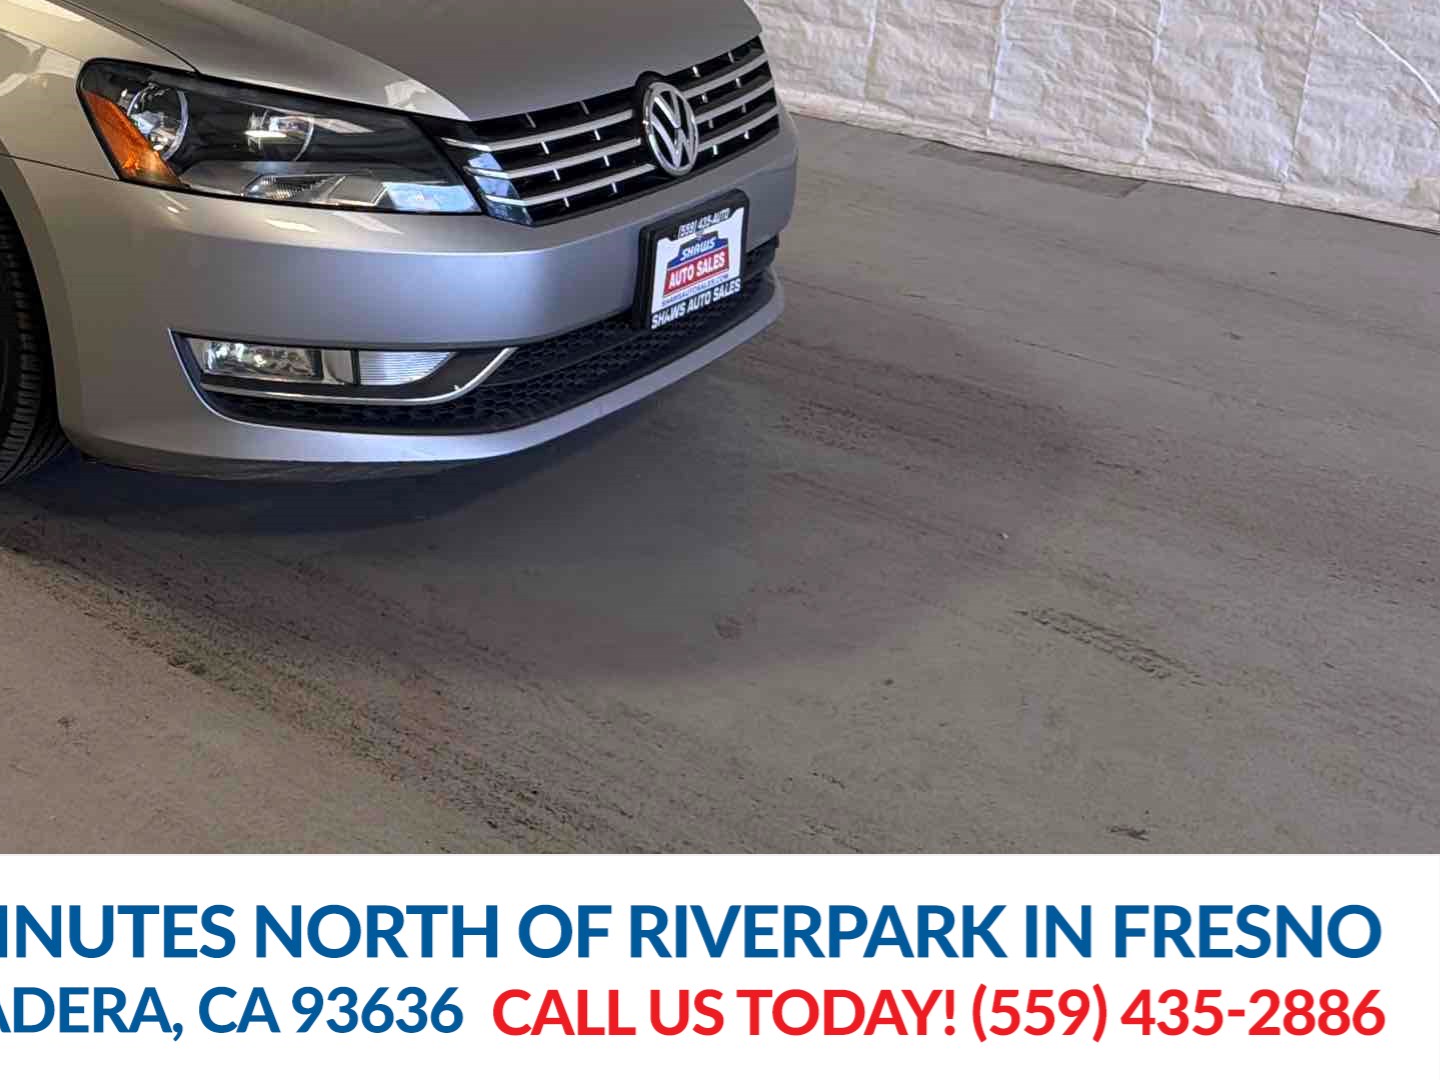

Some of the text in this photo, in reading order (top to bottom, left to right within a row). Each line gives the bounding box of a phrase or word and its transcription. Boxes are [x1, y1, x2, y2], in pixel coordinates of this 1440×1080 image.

[645, 83, 697, 174] VW
[668, 251, 726, 290] AUTO SALES
[680, 237, 715, 261] SHAWS
[651, 278, 742, 329] SHAWS AUTO SALES
